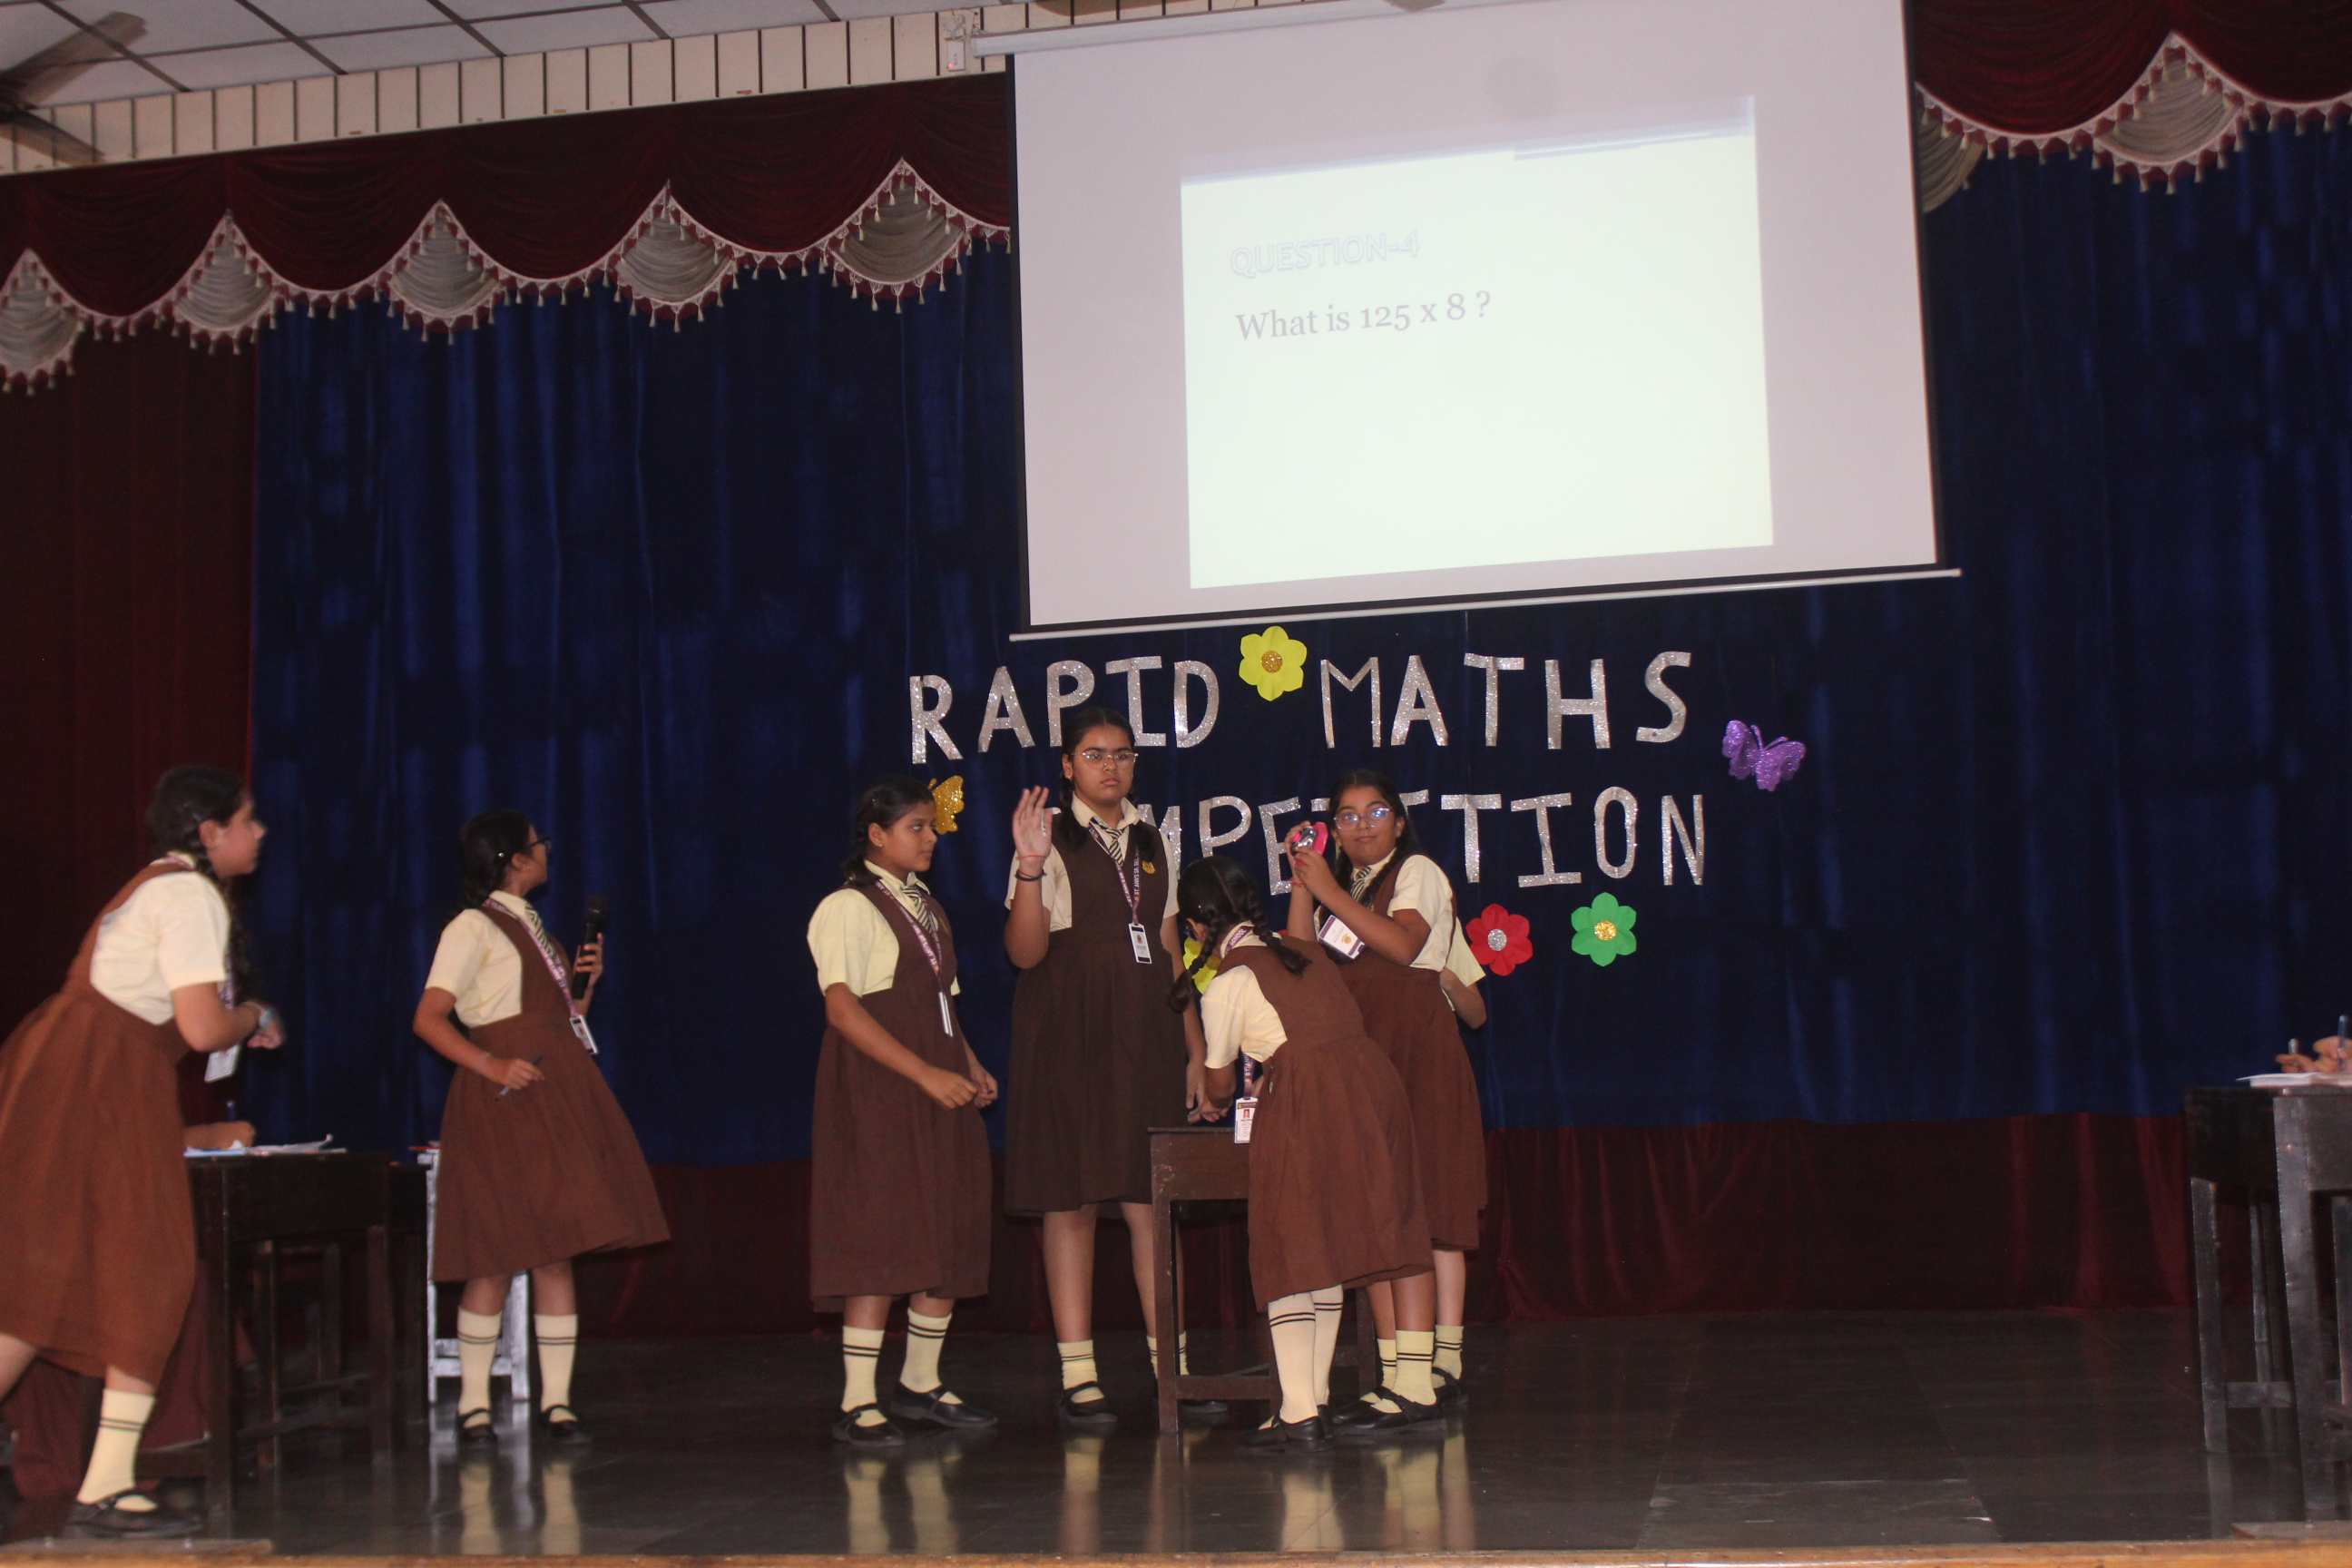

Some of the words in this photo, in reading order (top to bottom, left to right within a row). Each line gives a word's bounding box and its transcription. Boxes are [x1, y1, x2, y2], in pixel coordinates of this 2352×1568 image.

[1230, 229, 1421, 279] QUESTION-4
[1235, 308, 1318, 341] What
[1328, 304, 1351, 333] is
[1359, 304, 1411, 332] 125
[1419, 302, 1438, 324] x
[1446, 292, 1466, 321] 8
[1475, 289, 1492, 318] ?
[909, 655, 1220, 764] RAPID
[1320, 652, 1691, 750] MATHS
